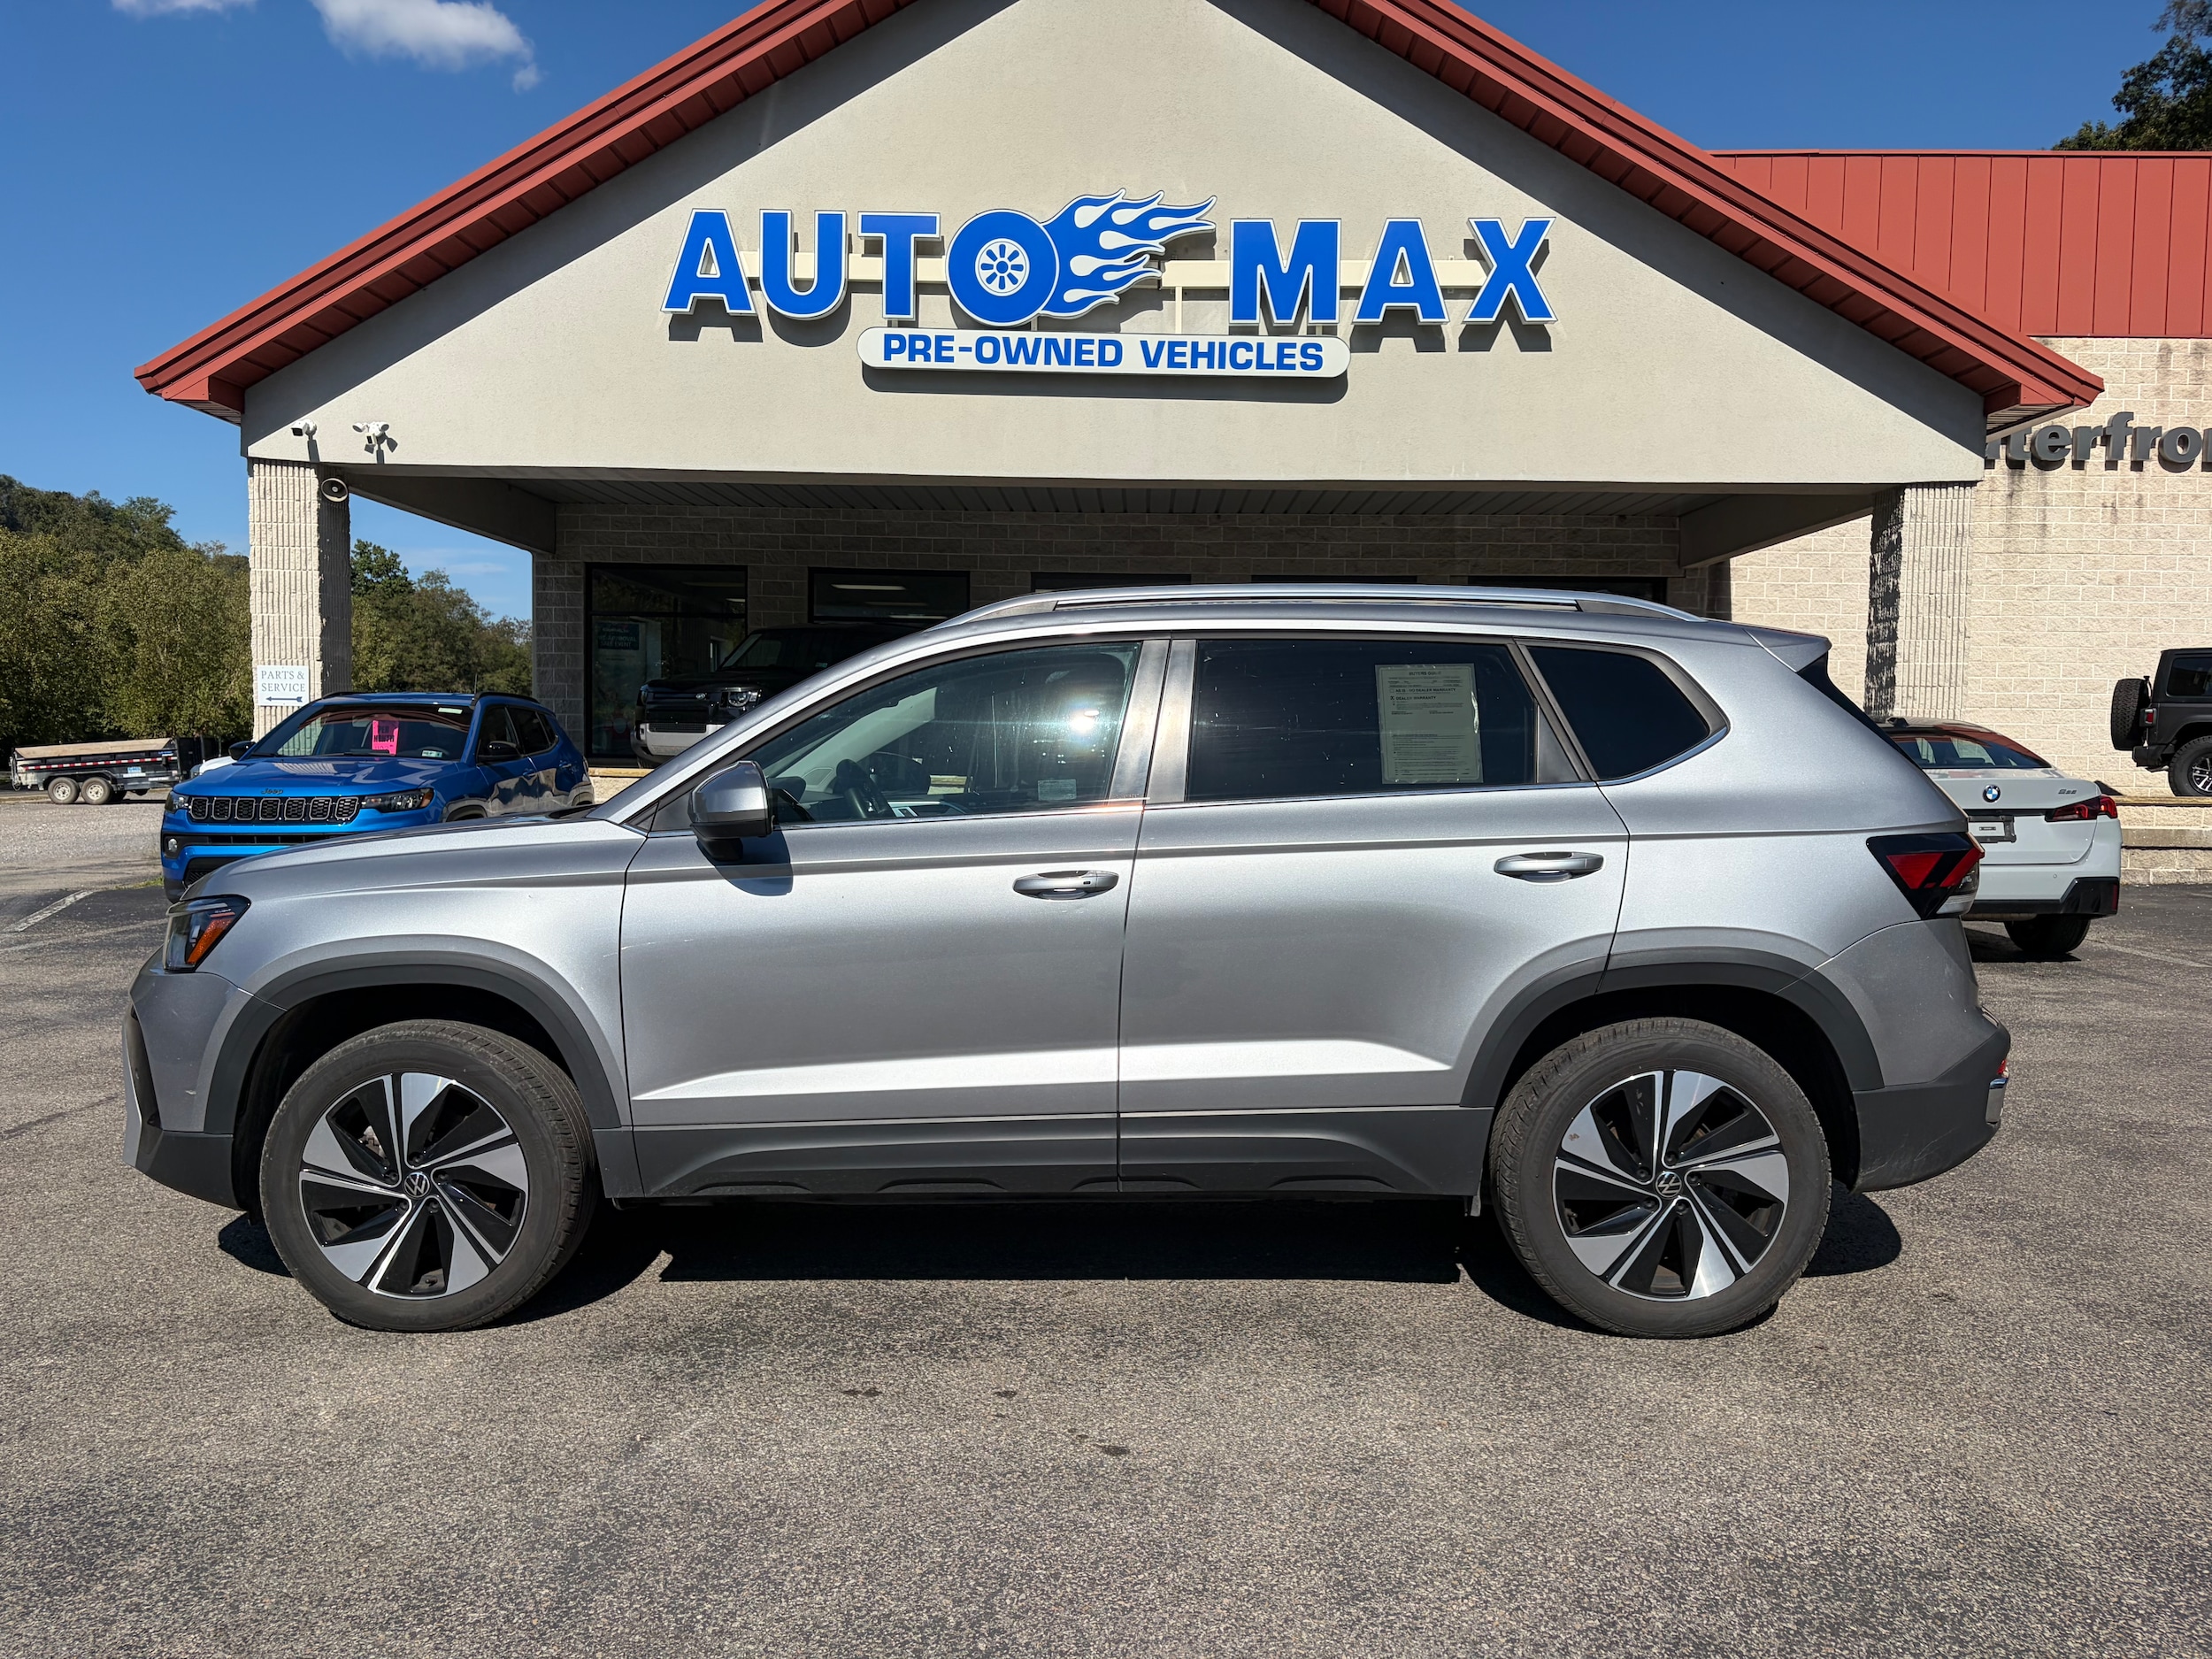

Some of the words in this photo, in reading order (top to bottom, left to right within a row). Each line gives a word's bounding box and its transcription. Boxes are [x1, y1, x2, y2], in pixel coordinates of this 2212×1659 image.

[662, 208, 1060, 326] AUTO
[1228, 217, 1558, 326] MAX
[884, 333, 1123, 368] PRE-OWNED
[1140, 340, 1325, 373] VEHICLES
[1985, 411, 2212, 465] terfro
[261, 670, 295, 680] PARTS
[297, 671, 304, 680] &
[261, 682, 306, 692] SERVICE
